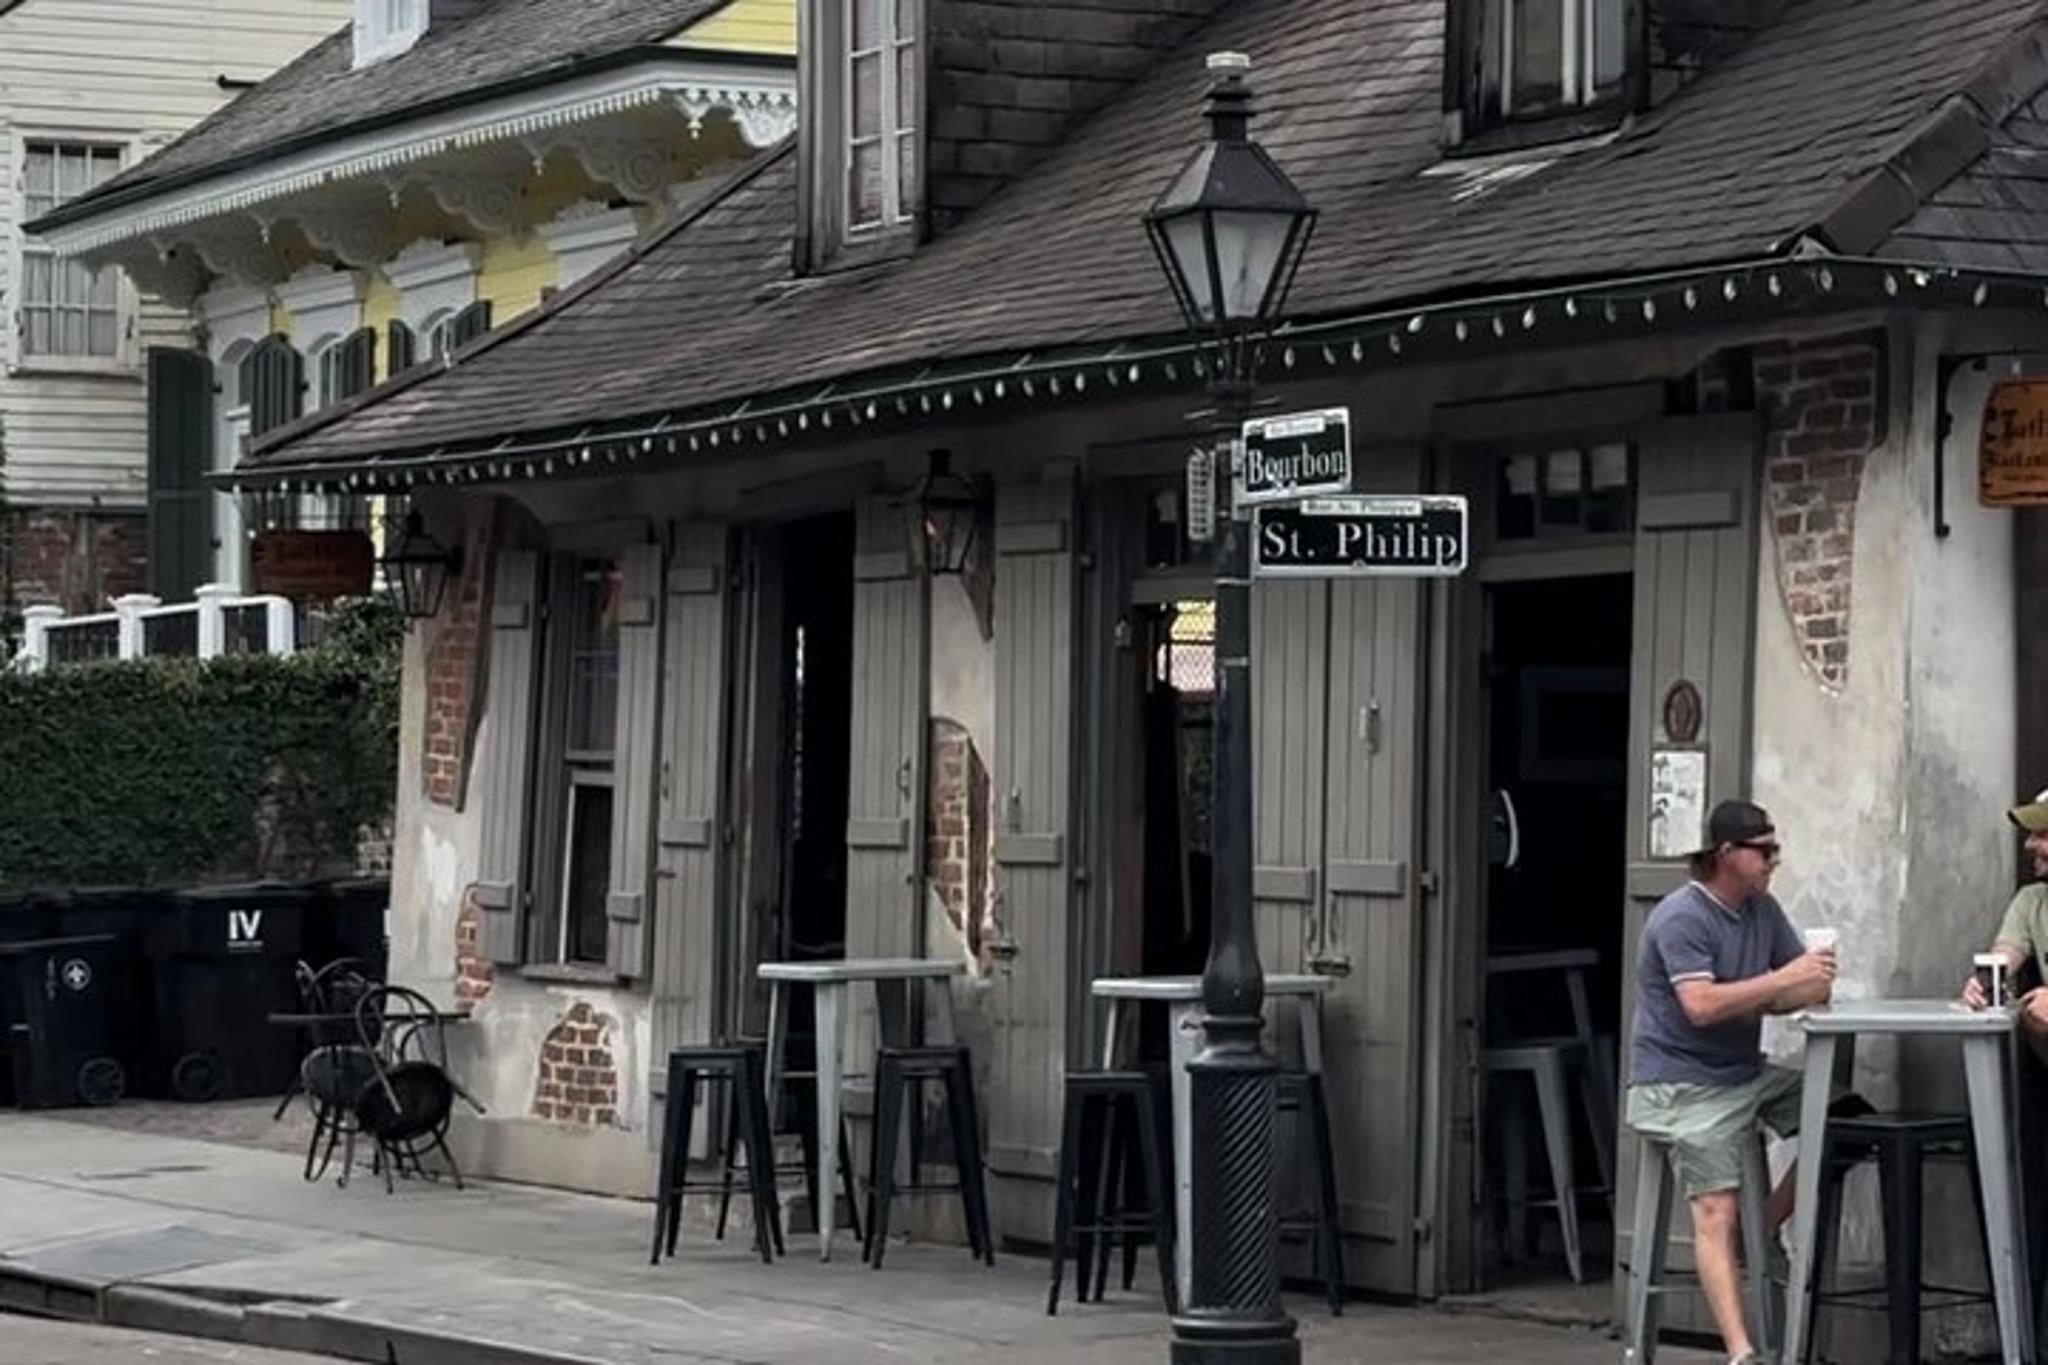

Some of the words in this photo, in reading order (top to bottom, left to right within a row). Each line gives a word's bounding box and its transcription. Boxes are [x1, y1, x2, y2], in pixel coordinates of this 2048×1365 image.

[1248, 441, 1344, 484] Bourbon
[1263, 522, 1315, 558] St.
[1337, 522, 1457, 566] Philip
[229, 910, 262, 940] IV
